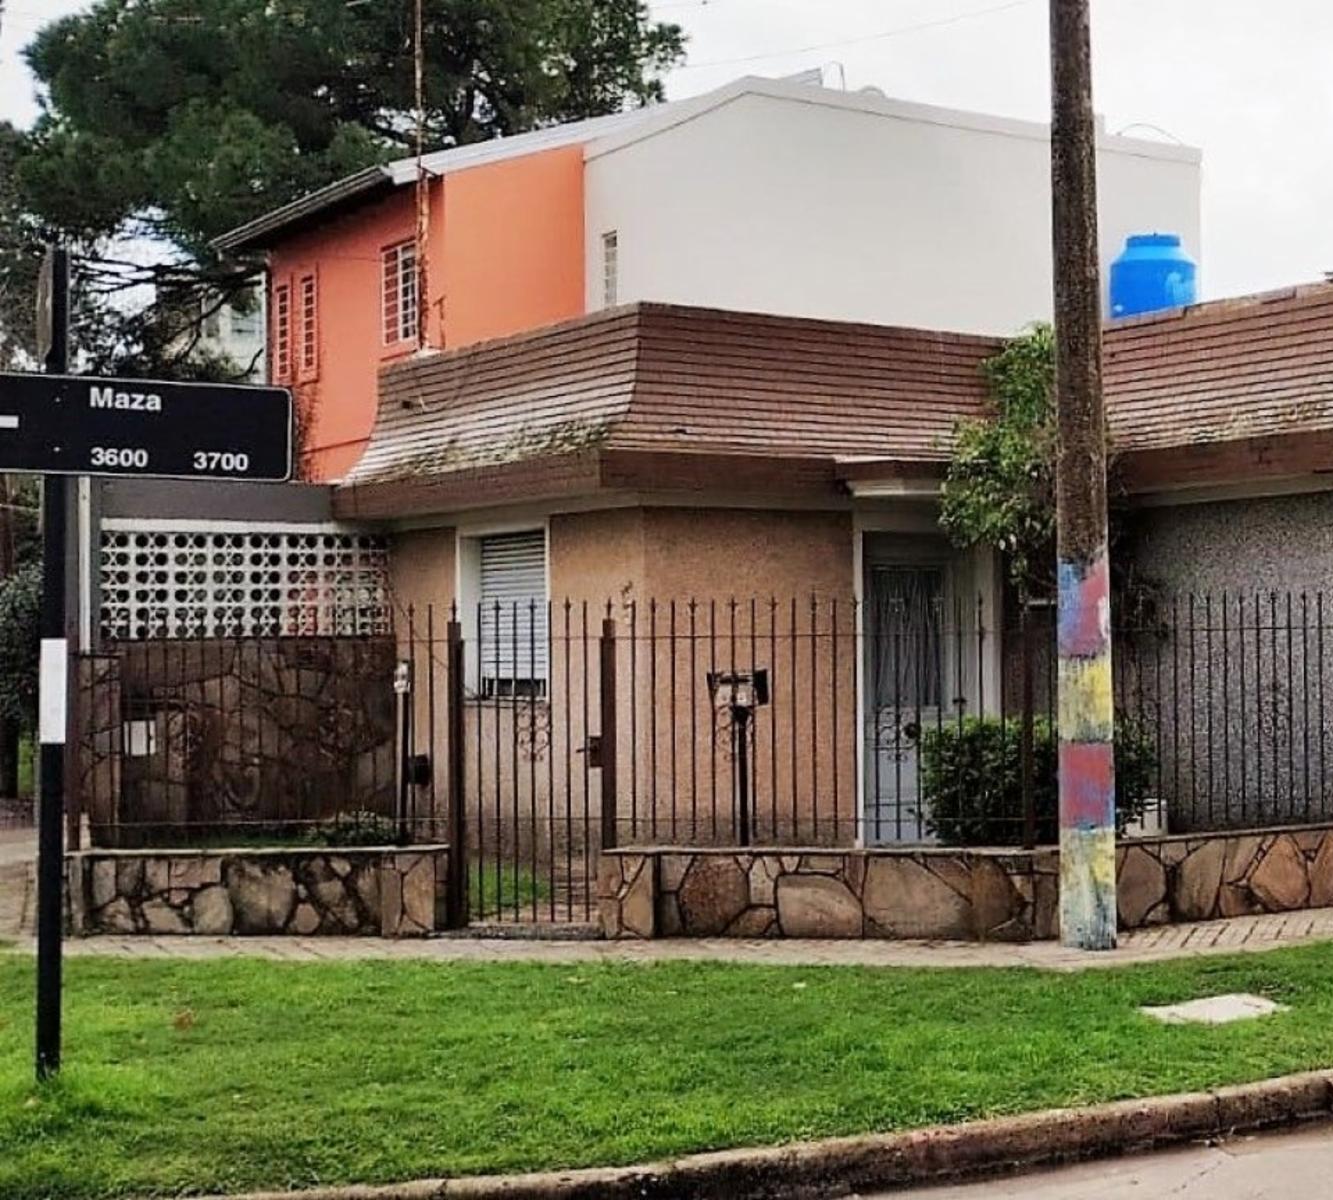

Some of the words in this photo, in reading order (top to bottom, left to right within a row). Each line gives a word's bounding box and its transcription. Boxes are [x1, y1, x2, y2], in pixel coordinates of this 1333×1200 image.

[89, 386, 162, 411] Maza
[90, 447, 149, 468] 3600
[193, 451, 249, 471] 3700
